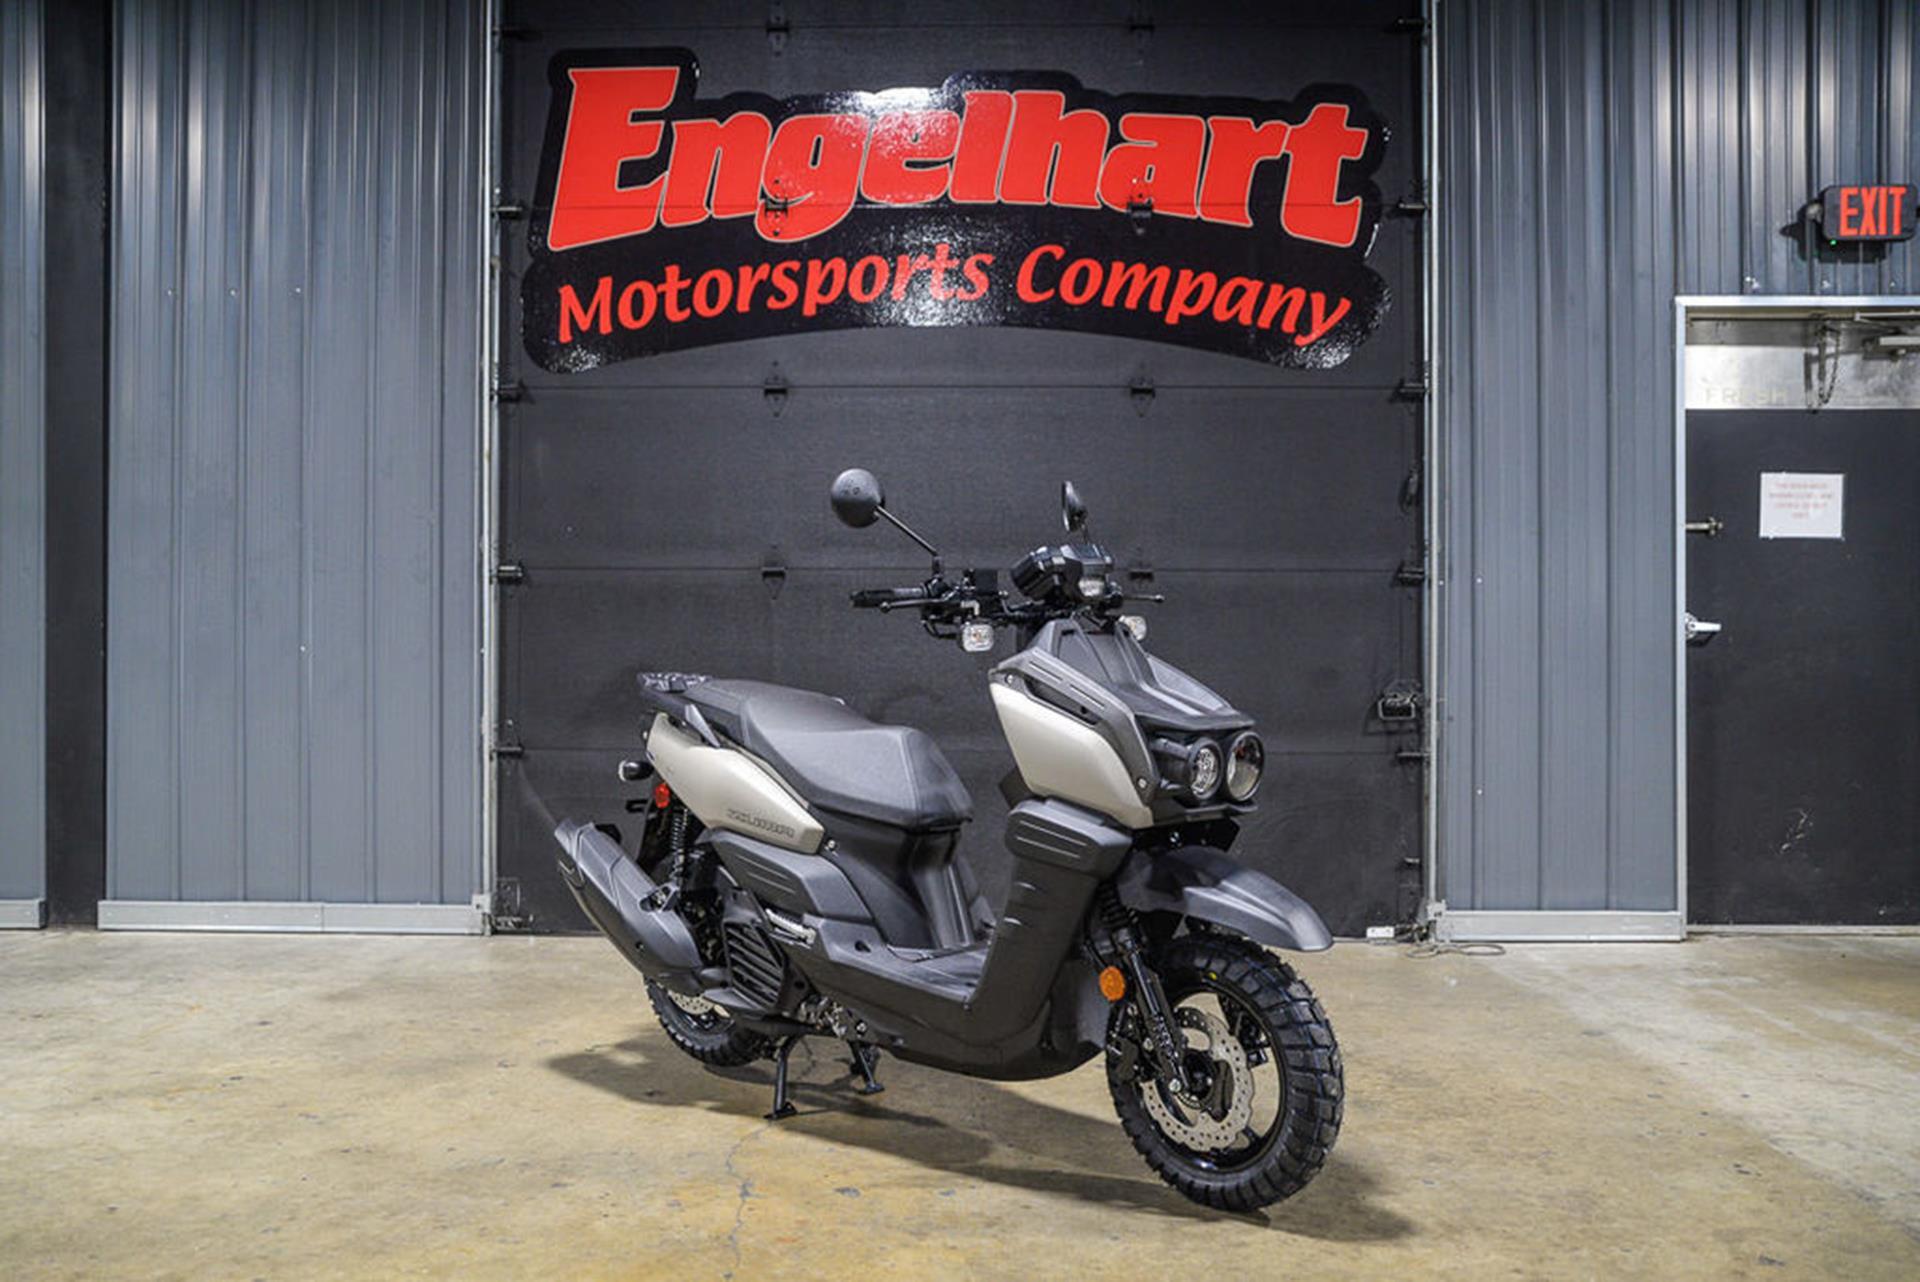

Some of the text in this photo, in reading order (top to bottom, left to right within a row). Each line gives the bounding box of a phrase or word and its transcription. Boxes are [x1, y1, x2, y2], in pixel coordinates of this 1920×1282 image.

[547, 66, 1369, 249] Engelhart
[1839, 186, 1907, 236] EXIT
[558, 242, 1352, 347] Motorsports Company
